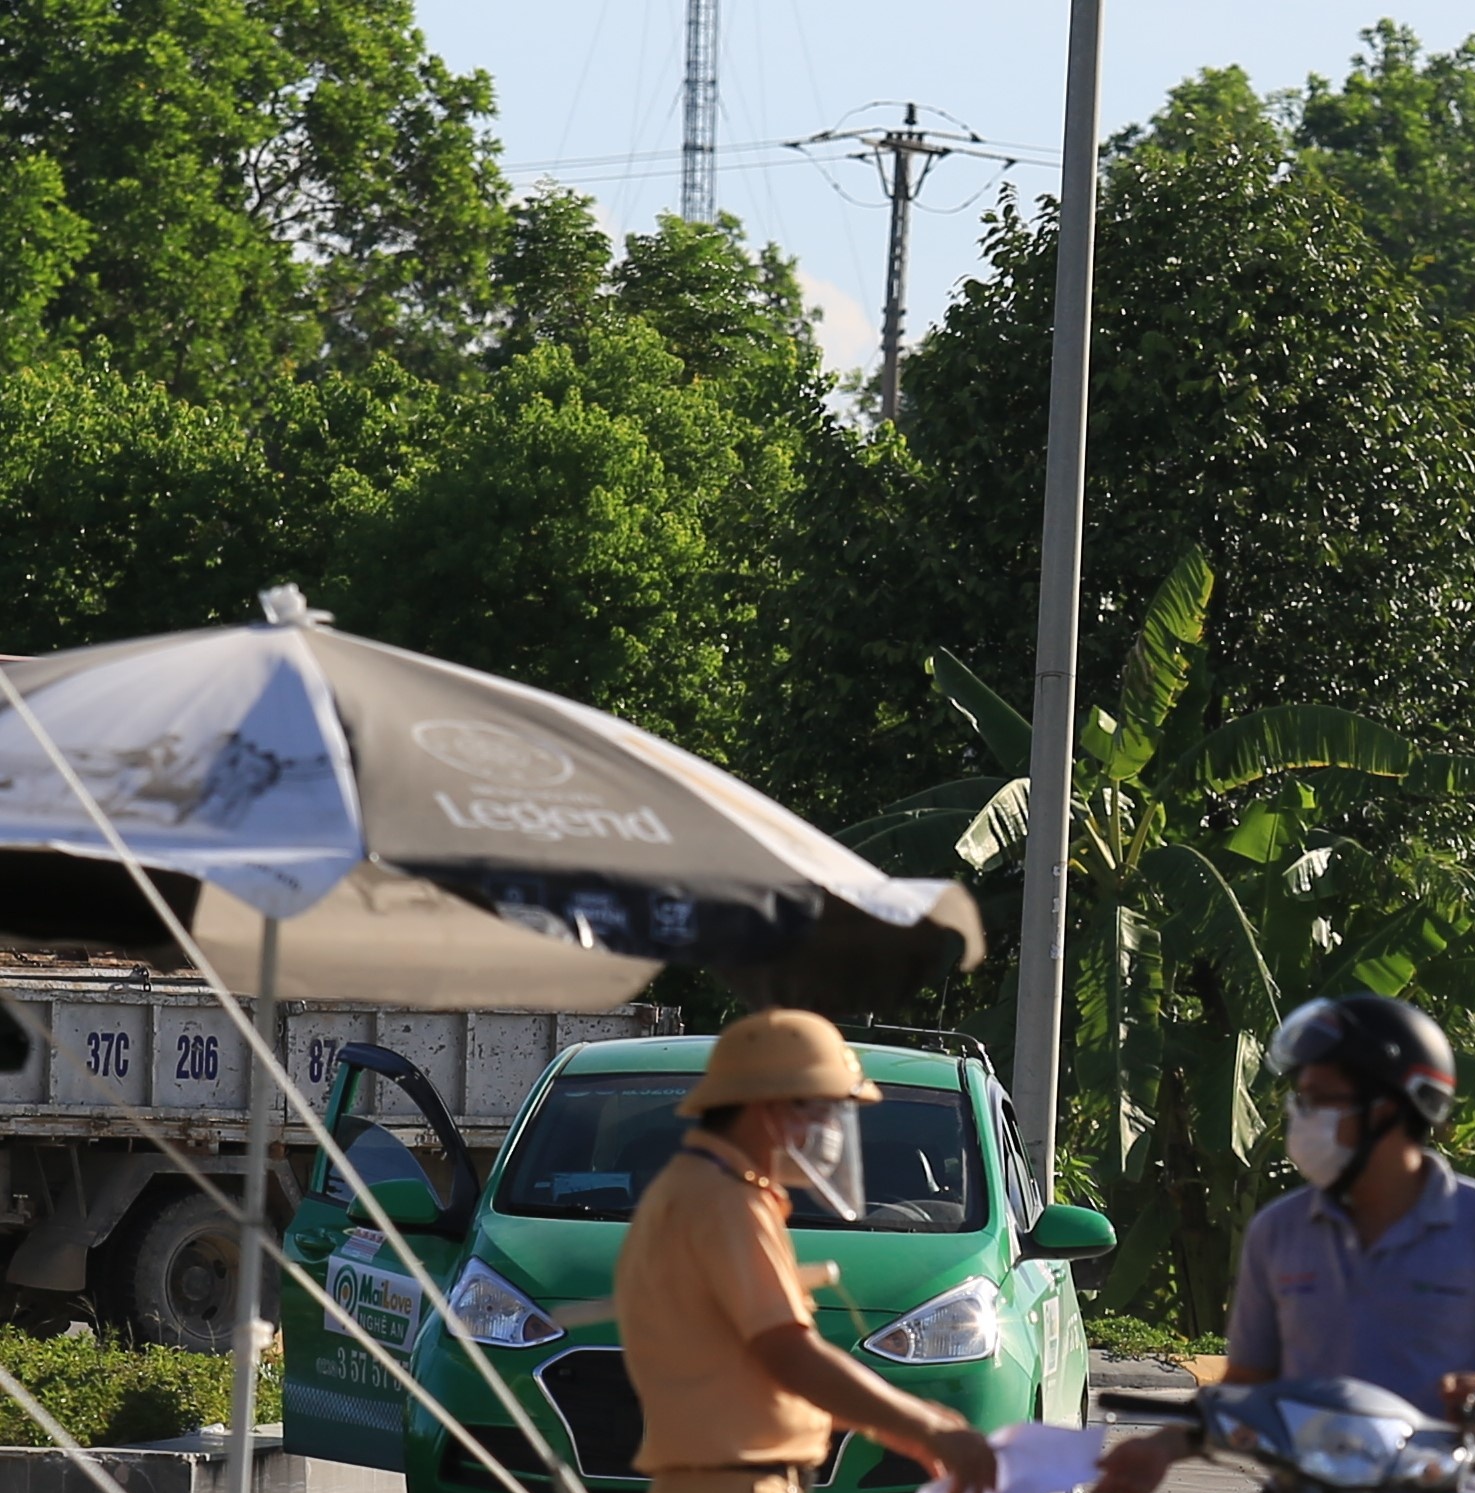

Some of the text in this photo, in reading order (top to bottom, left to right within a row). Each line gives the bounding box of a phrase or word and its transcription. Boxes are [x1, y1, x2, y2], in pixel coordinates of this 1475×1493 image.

[434, 791, 673, 843] Legend
[87, 1032, 337, 1083] 37C 206 87
[359, 1273, 412, 1315] MaiLove
[390, 1321, 404, 1338] AN
